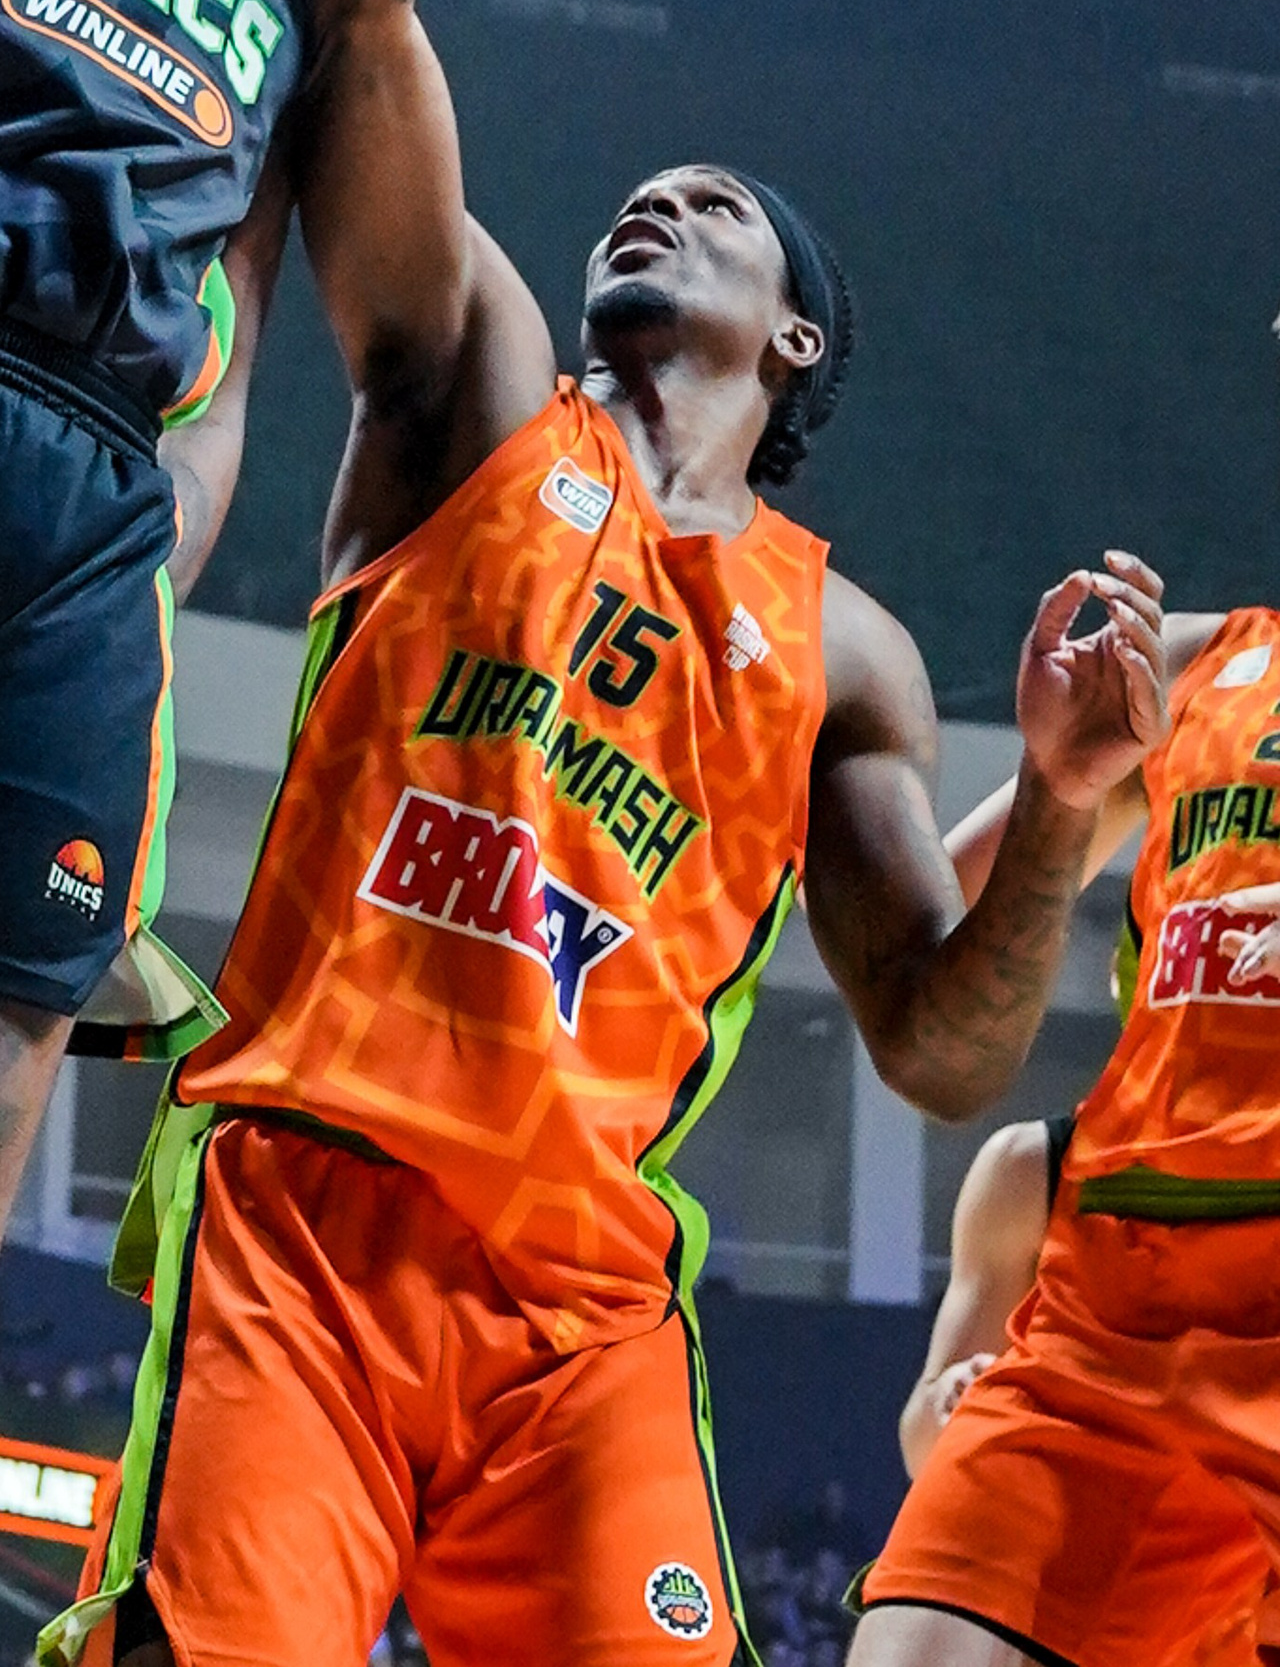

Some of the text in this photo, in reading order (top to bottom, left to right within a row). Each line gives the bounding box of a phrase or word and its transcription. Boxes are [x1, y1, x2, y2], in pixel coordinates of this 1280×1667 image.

[560, 481, 605, 518] WIN
[568, 580, 682, 708] 15
[412, 647, 711, 904] URAMASH
[47, 861, 104, 911] UNICS
